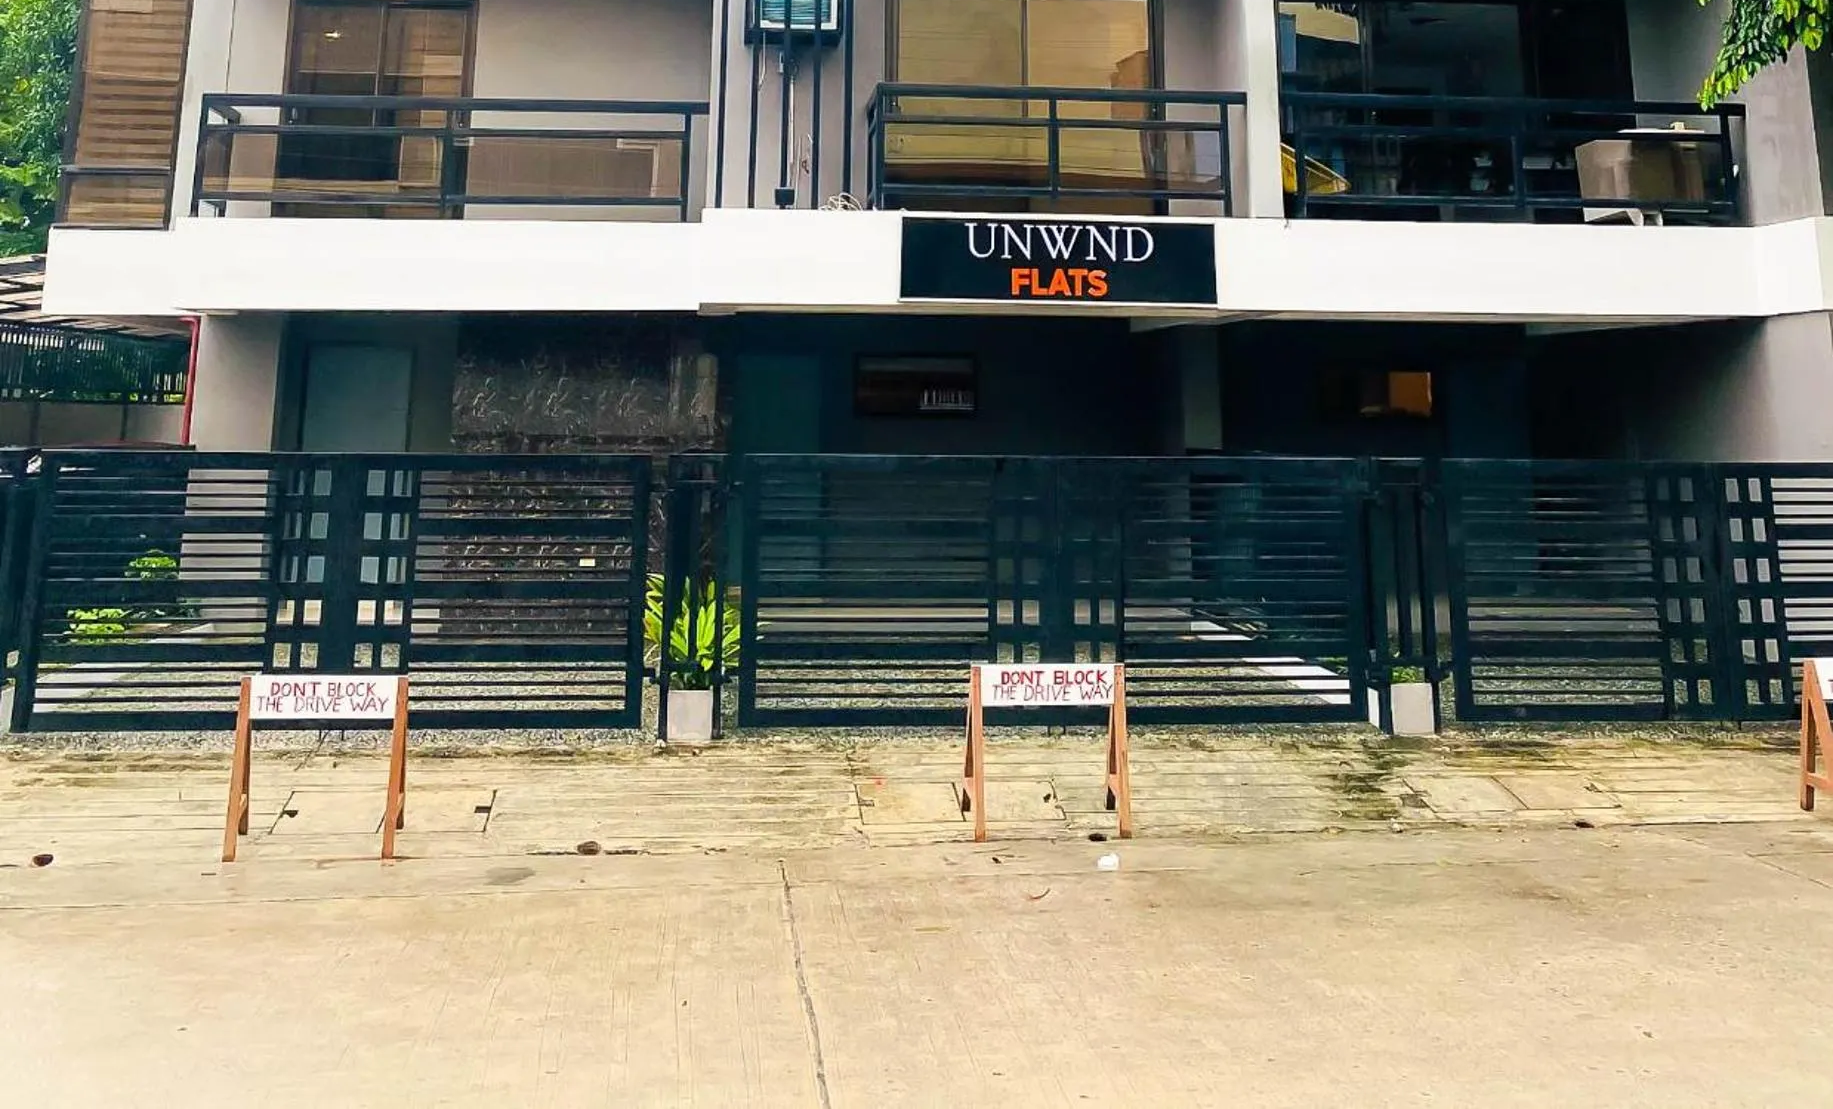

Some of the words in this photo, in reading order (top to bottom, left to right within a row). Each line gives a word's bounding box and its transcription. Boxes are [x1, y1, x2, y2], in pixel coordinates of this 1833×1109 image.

[964, 222, 1154, 262] UNWND
[1010, 267, 1109, 297] FLATS
[1053, 670, 1108, 685] BLOCK
[327, 682, 377, 697] BLOCK
[992, 684, 1017, 701] THE
[1023, 684, 1071, 701] DRIVE
[1080, 684, 1114, 701] WAY
[256, 696, 283, 713] THE
[294, 696, 342, 713] DRIVE
[350, 696, 389, 713] WAY
